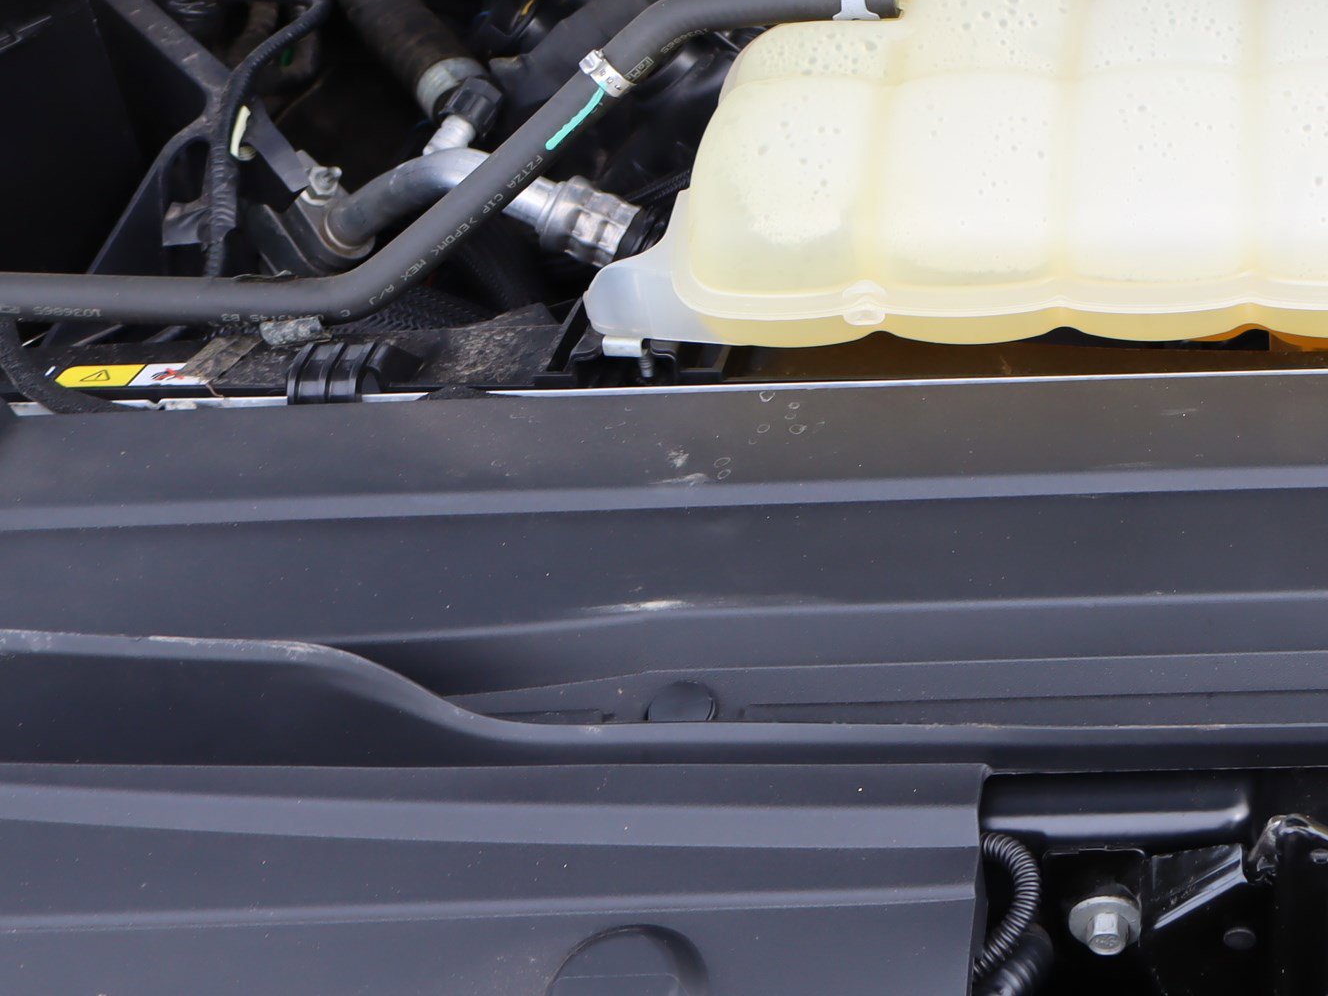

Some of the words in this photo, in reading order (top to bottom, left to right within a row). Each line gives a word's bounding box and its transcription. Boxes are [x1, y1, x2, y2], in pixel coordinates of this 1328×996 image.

[507, 155, 543, 189] FZTZA
[483, 193, 504, 214] CIP
[400, 259, 427, 281] MEX
